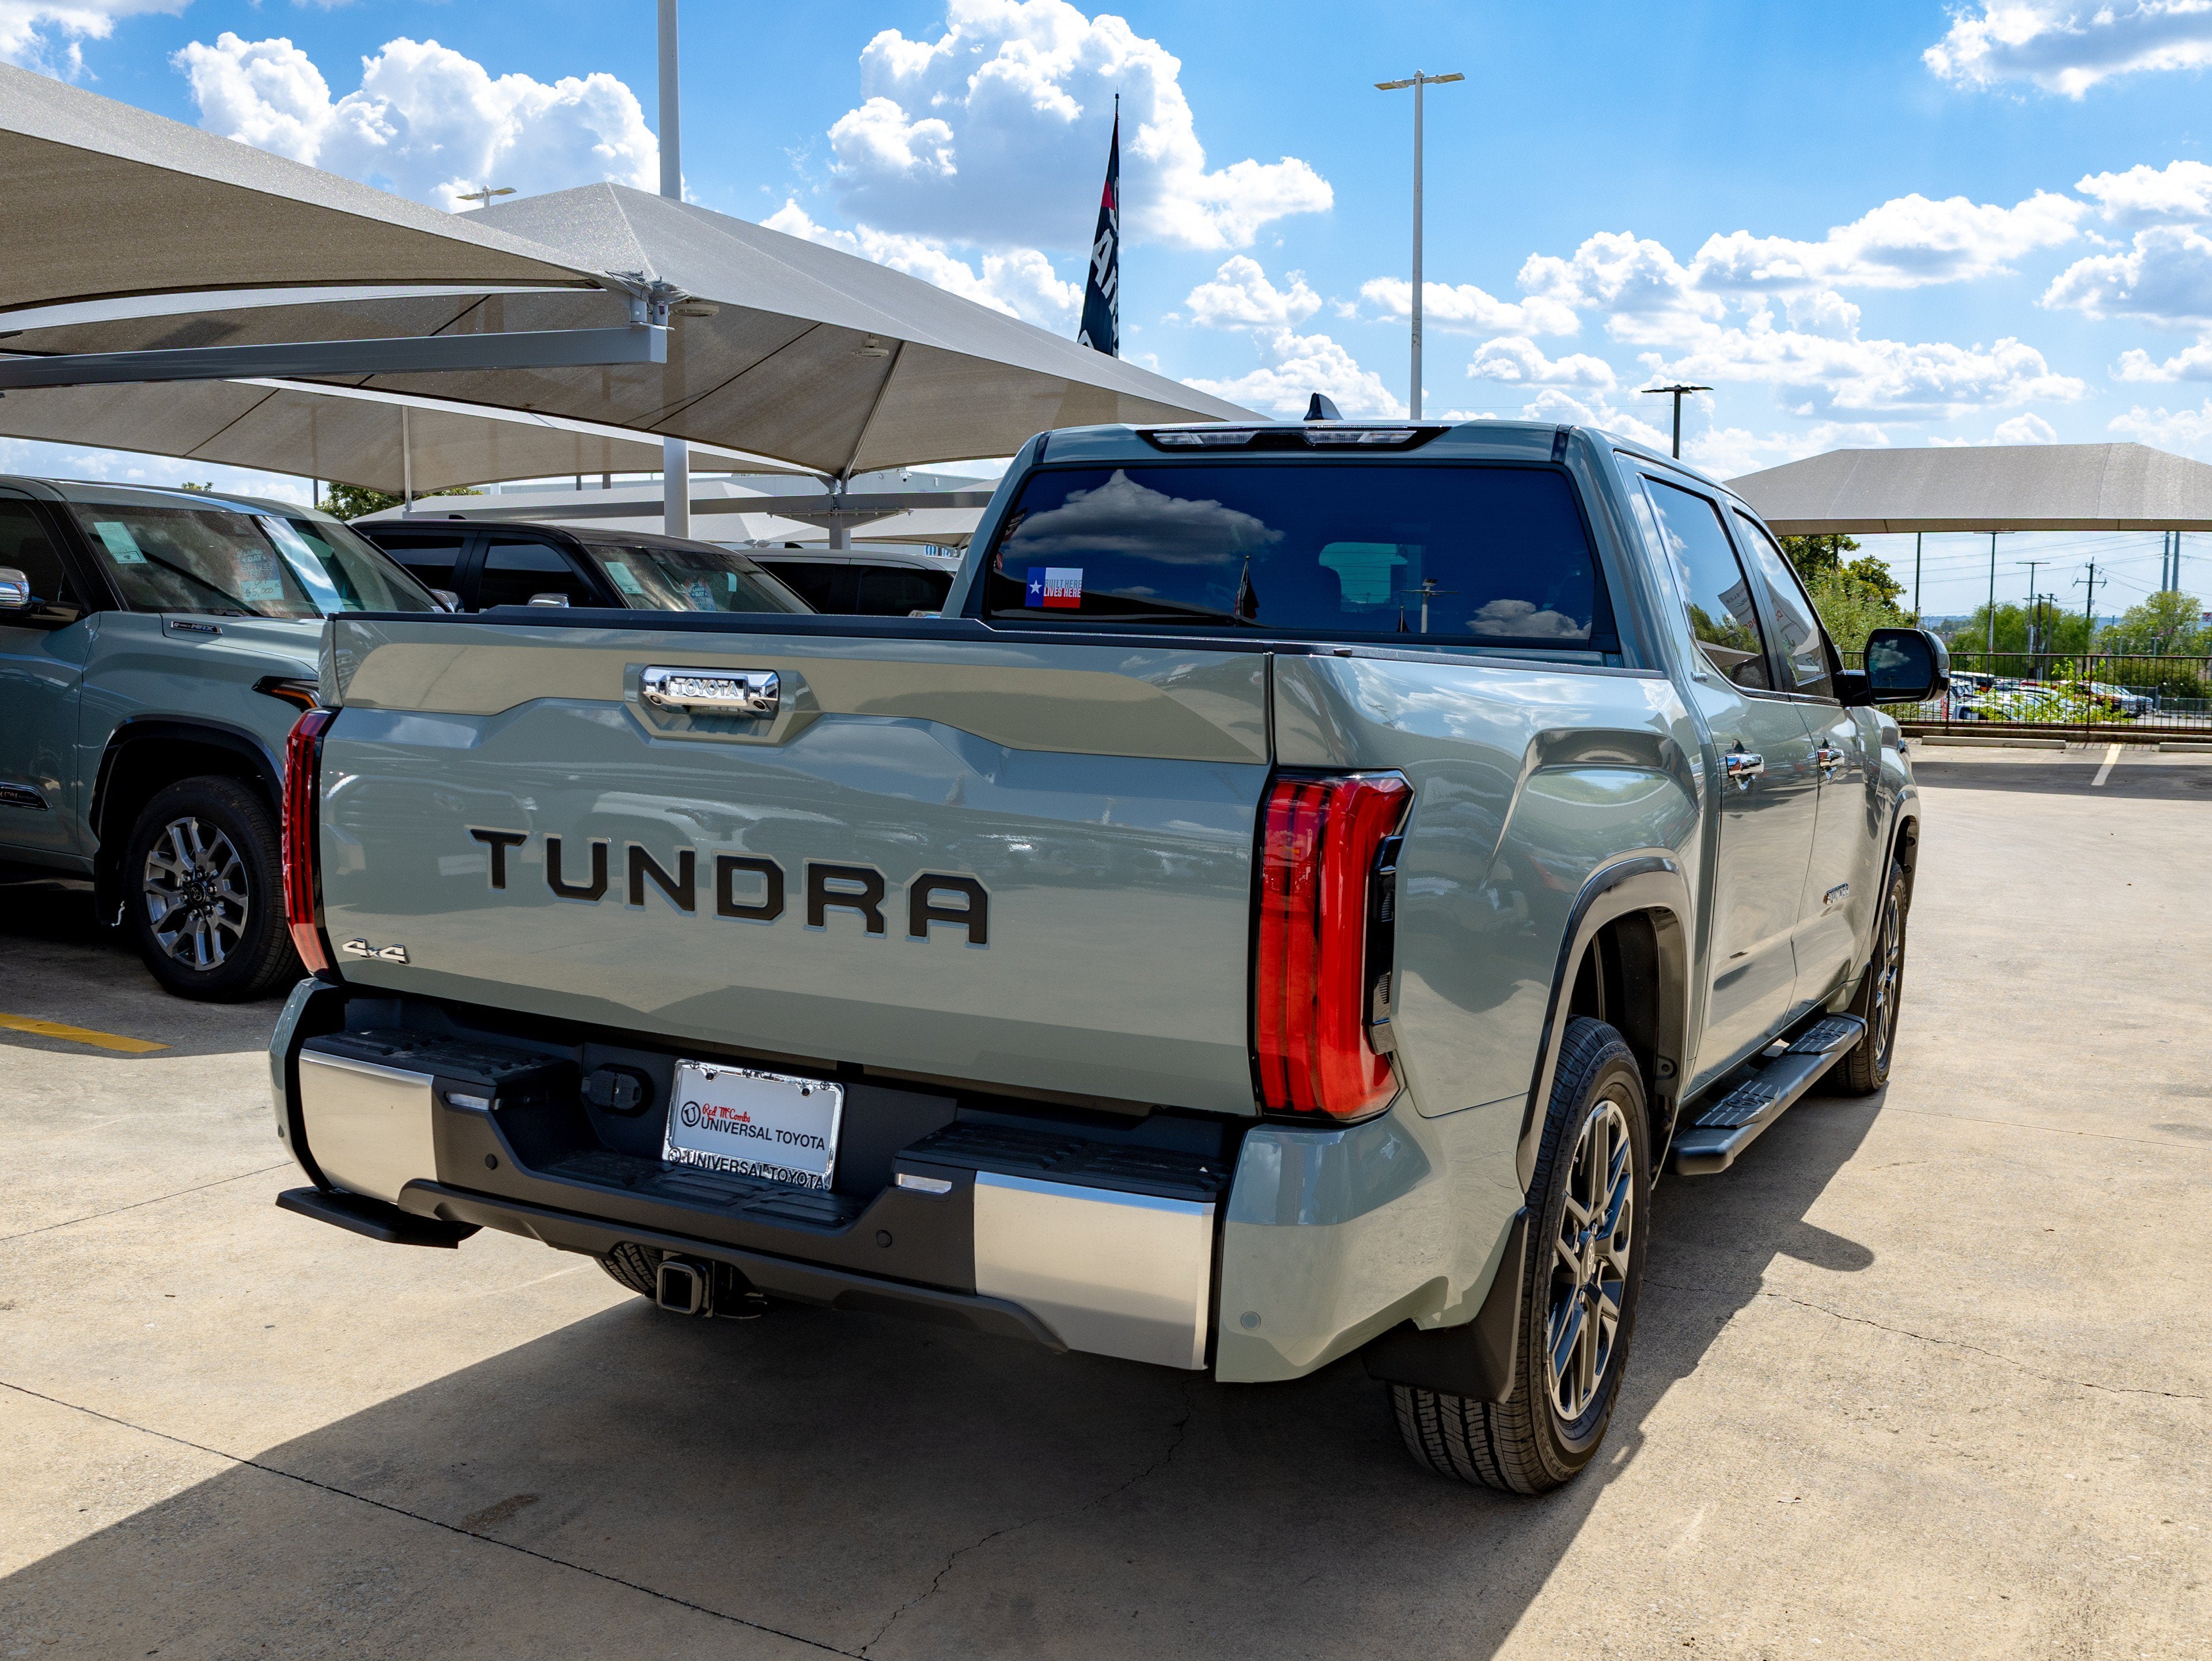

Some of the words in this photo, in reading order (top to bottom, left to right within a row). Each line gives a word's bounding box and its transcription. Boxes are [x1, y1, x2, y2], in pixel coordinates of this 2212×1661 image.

[1043, 587, 1062, 597] LIVES
[1063, 588, 1081, 597] HERE
[1045, 579, 1064, 588] BUILT
[1065, 579, 1082, 589] HERE
[674, 678, 738, 697] TOYOTA
[465, 825, 991, 949] TUNDRA
[702, 1103, 718, 1120] Red
[718, 1106, 751, 1123] McCombs
[701, 1117, 772, 1141] UNIVERSAL
[775, 1129, 825, 1151] TOYOTA
[686, 1151, 766, 1179] UNIVERSAL
[768, 1166, 825, 1190] TOYOTA
